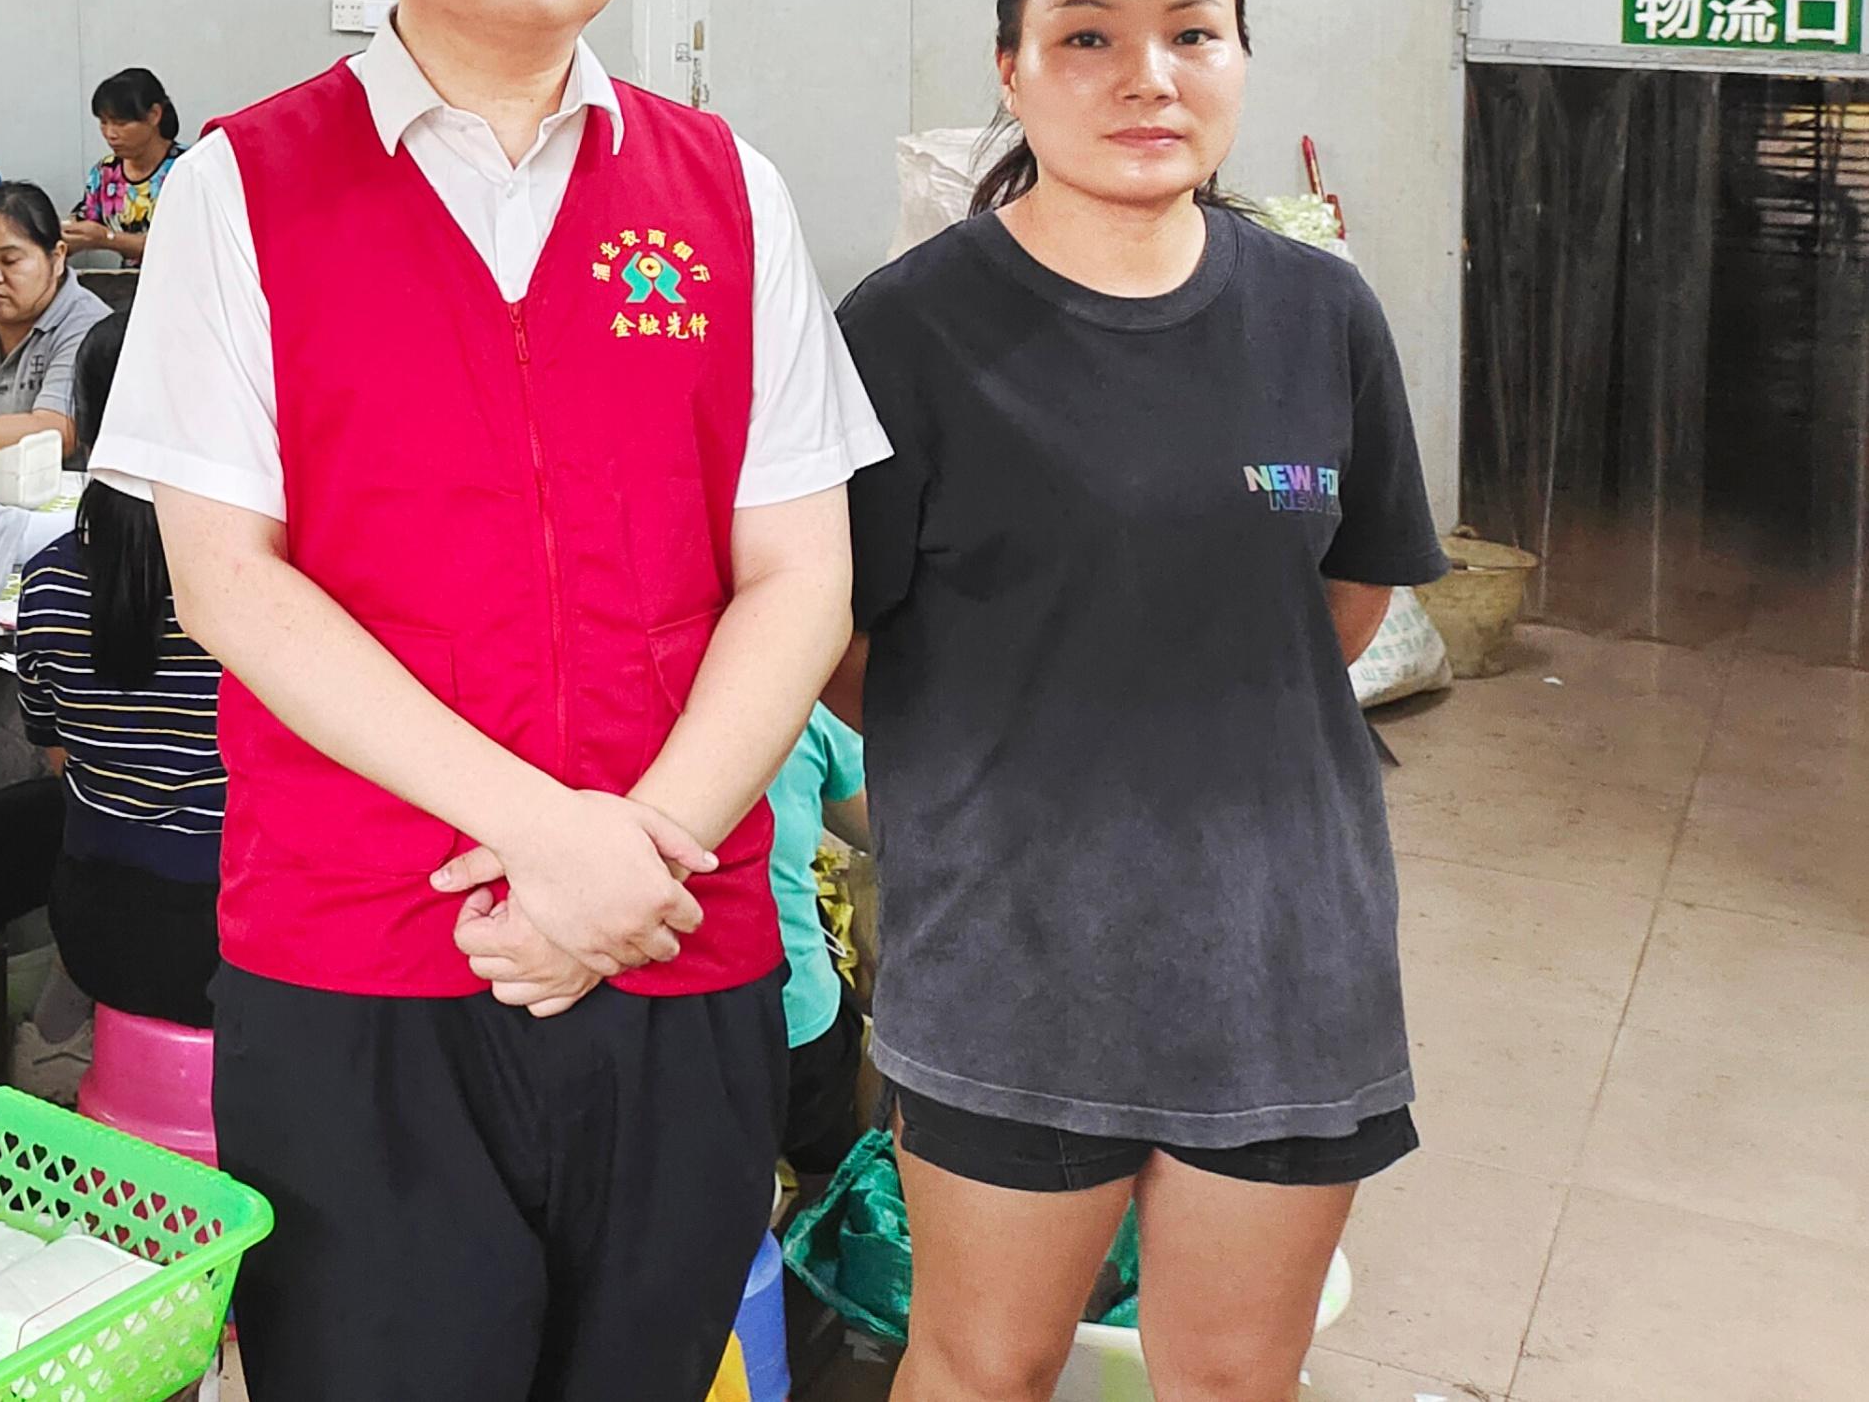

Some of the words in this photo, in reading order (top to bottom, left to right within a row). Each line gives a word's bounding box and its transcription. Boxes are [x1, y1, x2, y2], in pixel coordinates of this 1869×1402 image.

[609, 311, 710, 343] 金融先锋
[1242, 464, 1312, 492] NEW
